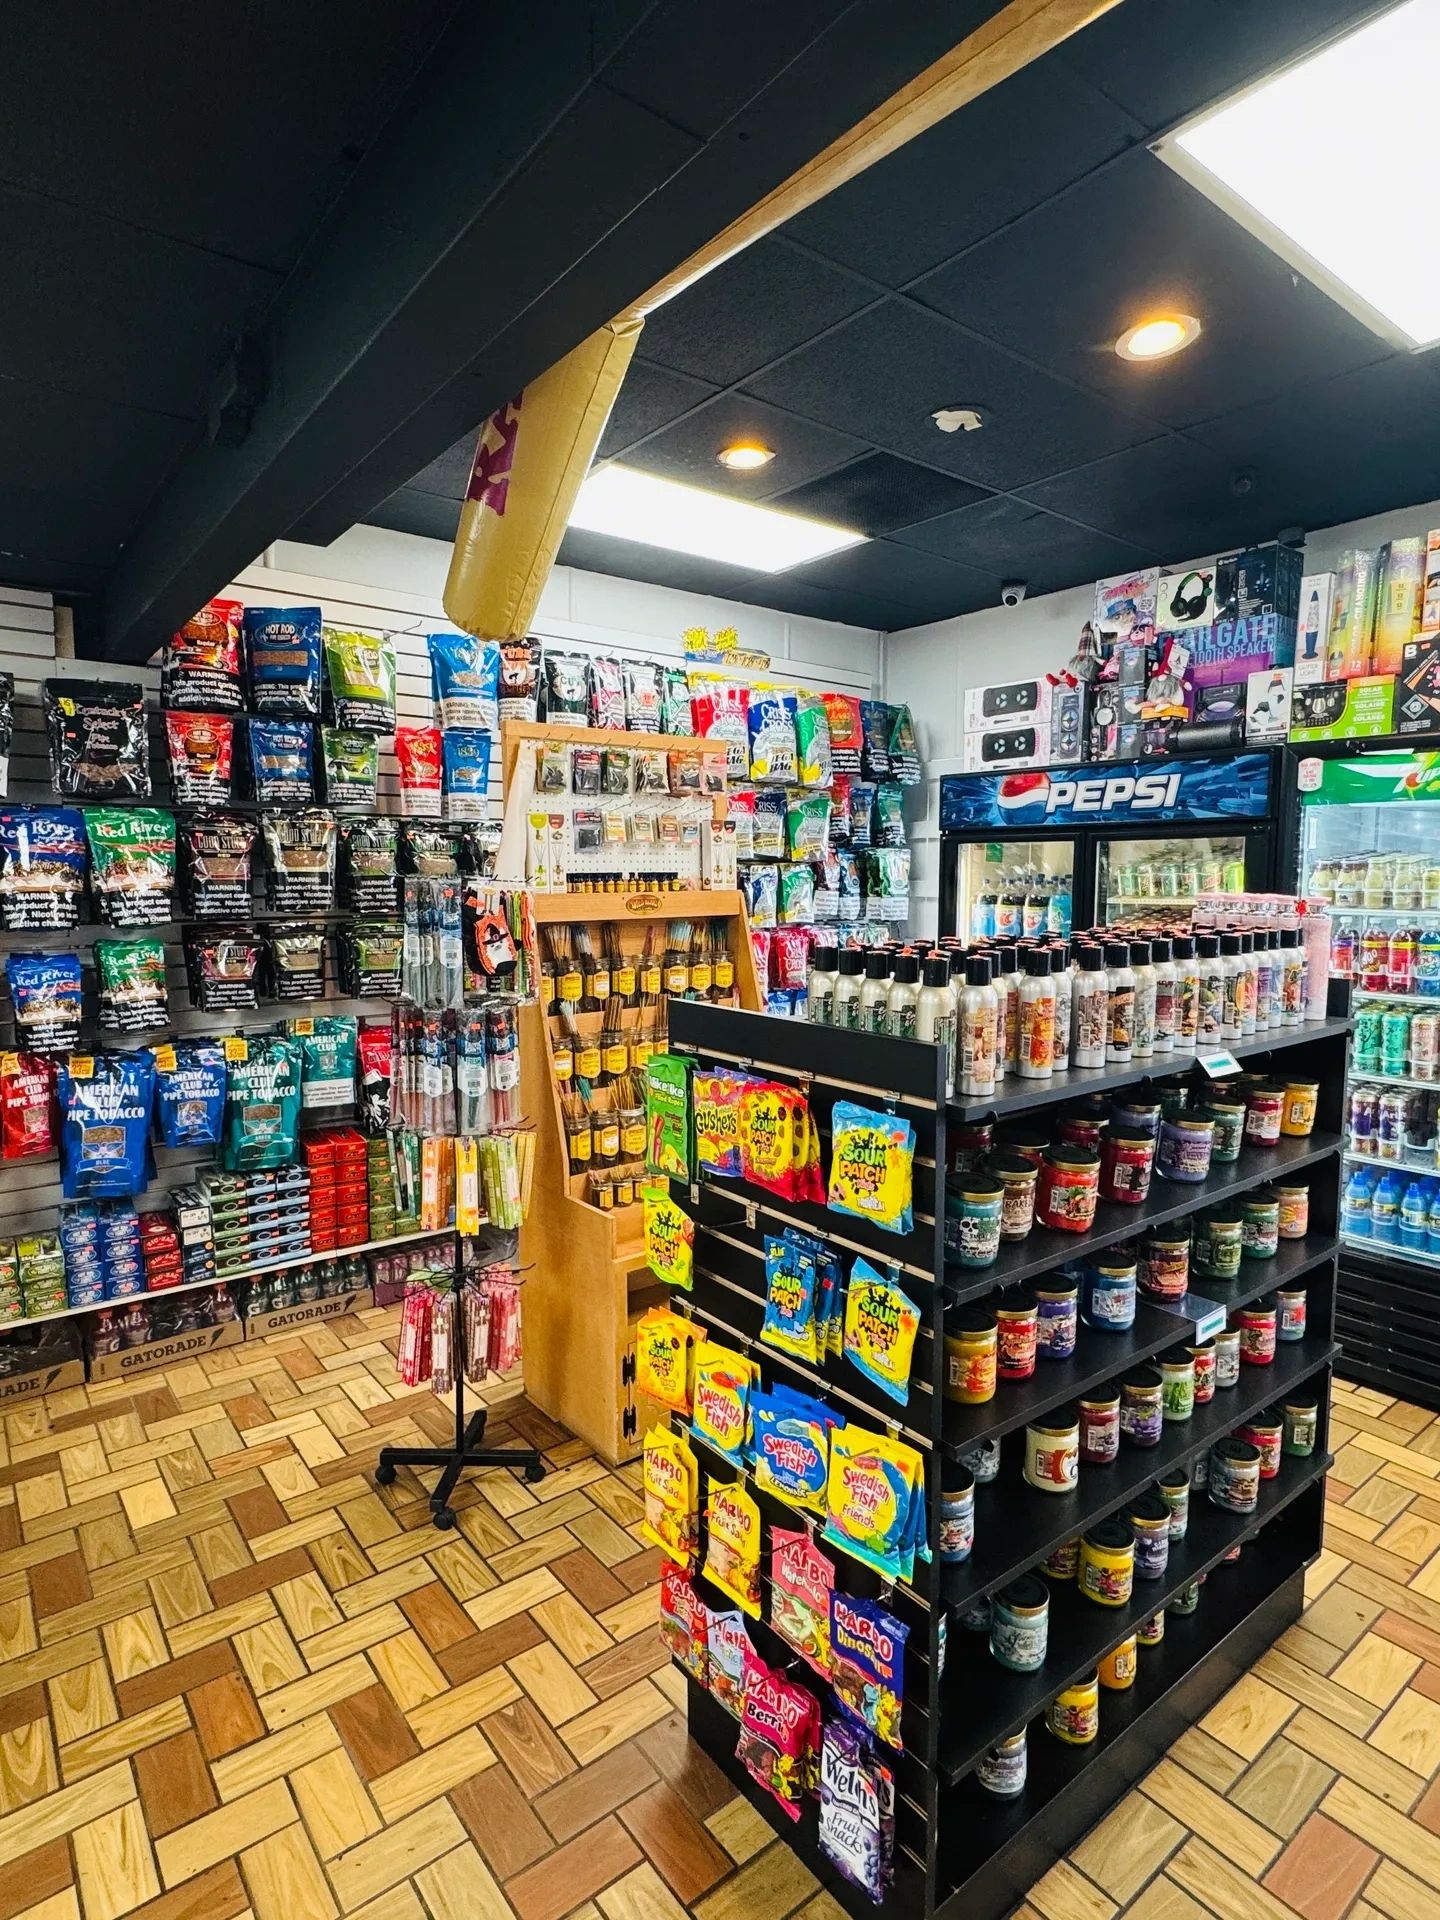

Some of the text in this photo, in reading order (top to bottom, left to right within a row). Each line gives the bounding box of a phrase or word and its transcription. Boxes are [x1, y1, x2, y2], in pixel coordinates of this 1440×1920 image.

[265, 623, 295, 634] HOT ROD
[1166, 614, 1277, 654] AILGATE
[1227, 639, 1275, 661] SPEAKER
[188, 671, 229, 681] WARNING:
[761, 704, 792, 720] CRISS
[83, 717, 119, 731] Select
[1045, 773, 1182, 813] PEPSI
[754, 799, 777, 812] CRISS
[802, 805, 824, 817] CRISS
[96, 821, 171, 838] Red River
[15, 902, 48, 913] product
[16, 970, 75, 986] Red River
[305, 1032, 349, 1047] AMERICAN
[317, 1043, 337, 1052] CLUB
[168, 1071, 214, 1084] AMERICAN
[233, 1065, 290, 1080] AMERICAN
[24, 1084, 43, 1095] CLUB
[180, 1080, 203, 1090] CLUB
[247, 1077, 274, 1089] CLUB
[163, 1088, 220, 1101] PIPE TOBACCO
[227, 1089, 250, 1101] PIPE
[251, 1085, 296, 1101] TOBACCO
[6, 1096, 28, 1108] PIPE
[67, 1107, 145, 1121] PIPE TOBACCO
[751, 1118, 776, 1131] SOUR
[751, 1131, 776, 1147] PATCH
[842, 1143, 885, 1167] SOUR
[839, 1160, 887, 1184] PATCH
[650, 1233, 680, 1260] PATCH
[772, 1271, 801, 1292] SOUR
[770, 1288, 802, 1311] PATCH
[268, 1302, 341, 1329] GATORADE
[861, 1296, 899, 1328] SOUR
[858, 1310, 899, 1346] PATCH
[120, 1335, 207, 1369] GATORADE
[697, 1383, 741, 1428] Swedish
[704, 1402, 729, 1437] Fish
[763, 1433, 818, 1468] Swedish
[776, 1450, 806, 1477] Fish
[646, 1467, 662, 1487] Fruit
[843, 1466, 890, 1504] Swedish
[850, 1484, 879, 1514] Fish
[711, 1513, 730, 1529] Fruit
[842, 1503, 876, 1530] Friends
[831, 1811, 862, 1836] Fruit
[826, 1816, 863, 1855] Snacks
